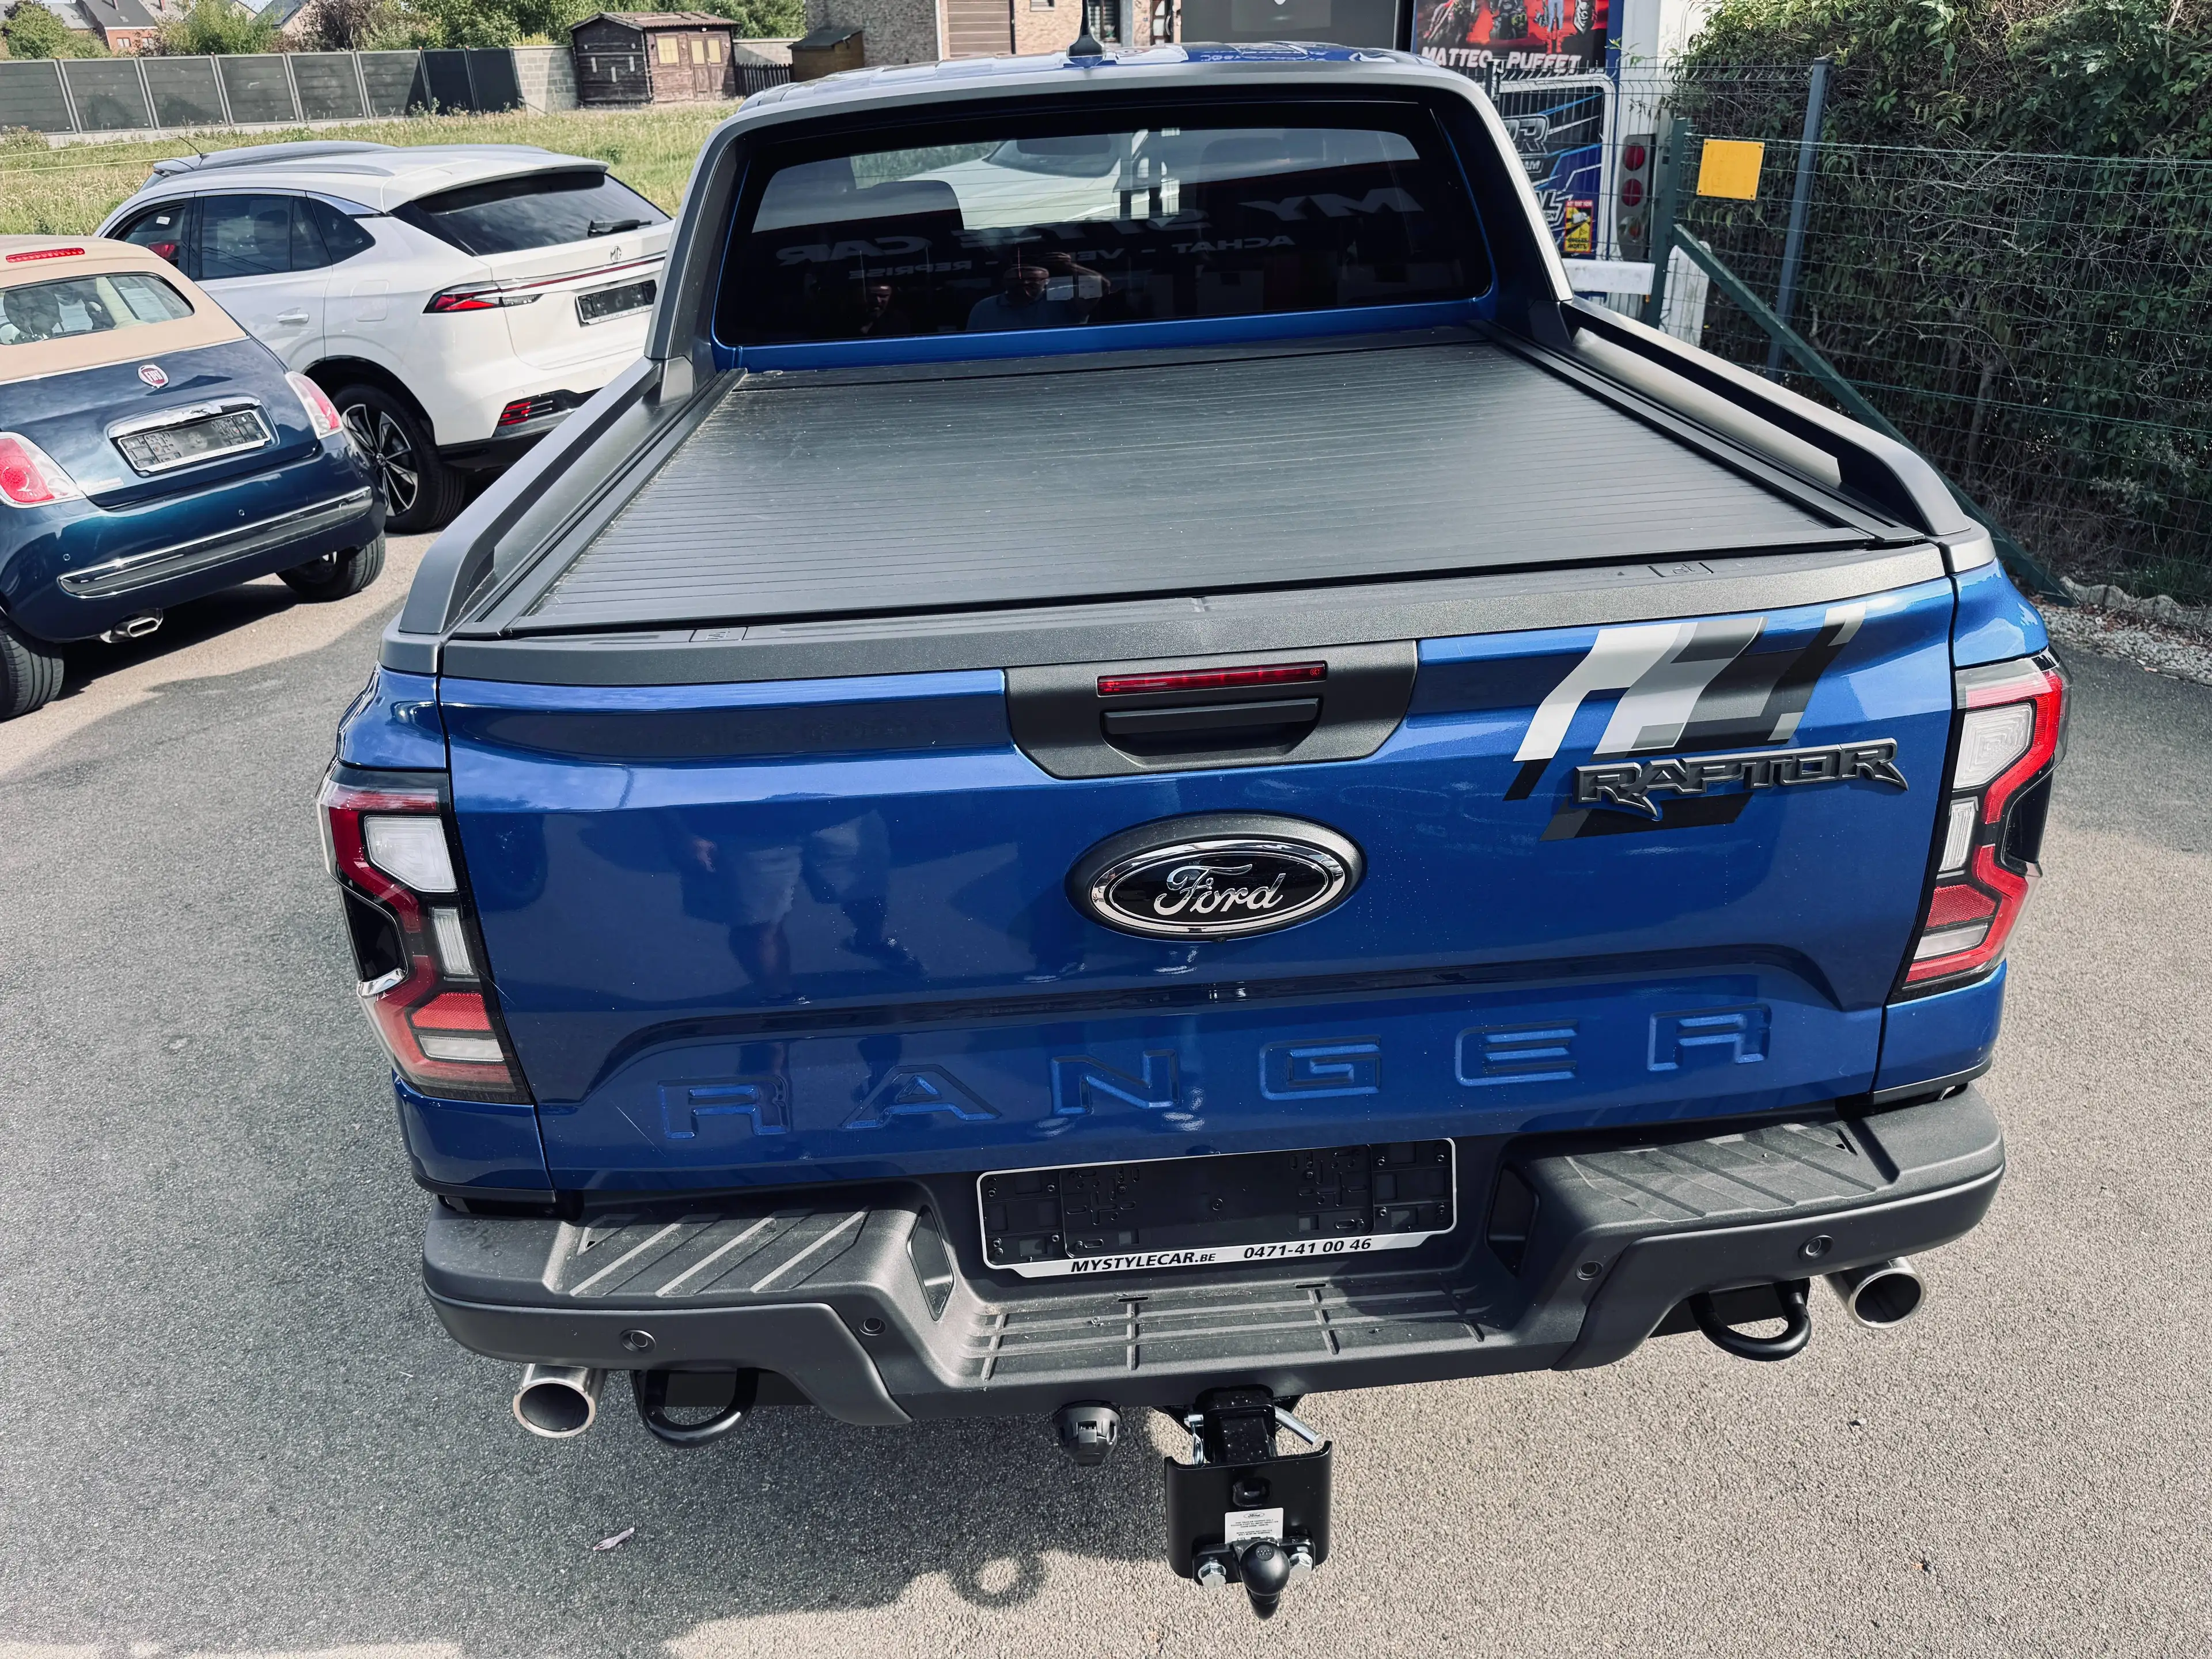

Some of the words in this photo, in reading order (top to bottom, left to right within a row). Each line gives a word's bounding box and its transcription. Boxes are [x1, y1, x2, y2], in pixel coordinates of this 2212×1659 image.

[1421, 46, 1493, 69] MATTEO
[1506, 51, 1582, 74] PUFFET
[144, 369, 163, 382] FIAT
[1574, 737, 1909, 820] RAPTOR
[1153, 863, 1285, 915] Ford
[657, 1002, 1772, 1139] RANGER
[1070, 1251, 1216, 1272] MYSTYLECAR.BE
[1243, 1242, 1316, 1259] 0471-41
[1323, 1240, 1344, 1252] 00
[1349, 1238, 1372, 1251] 46
